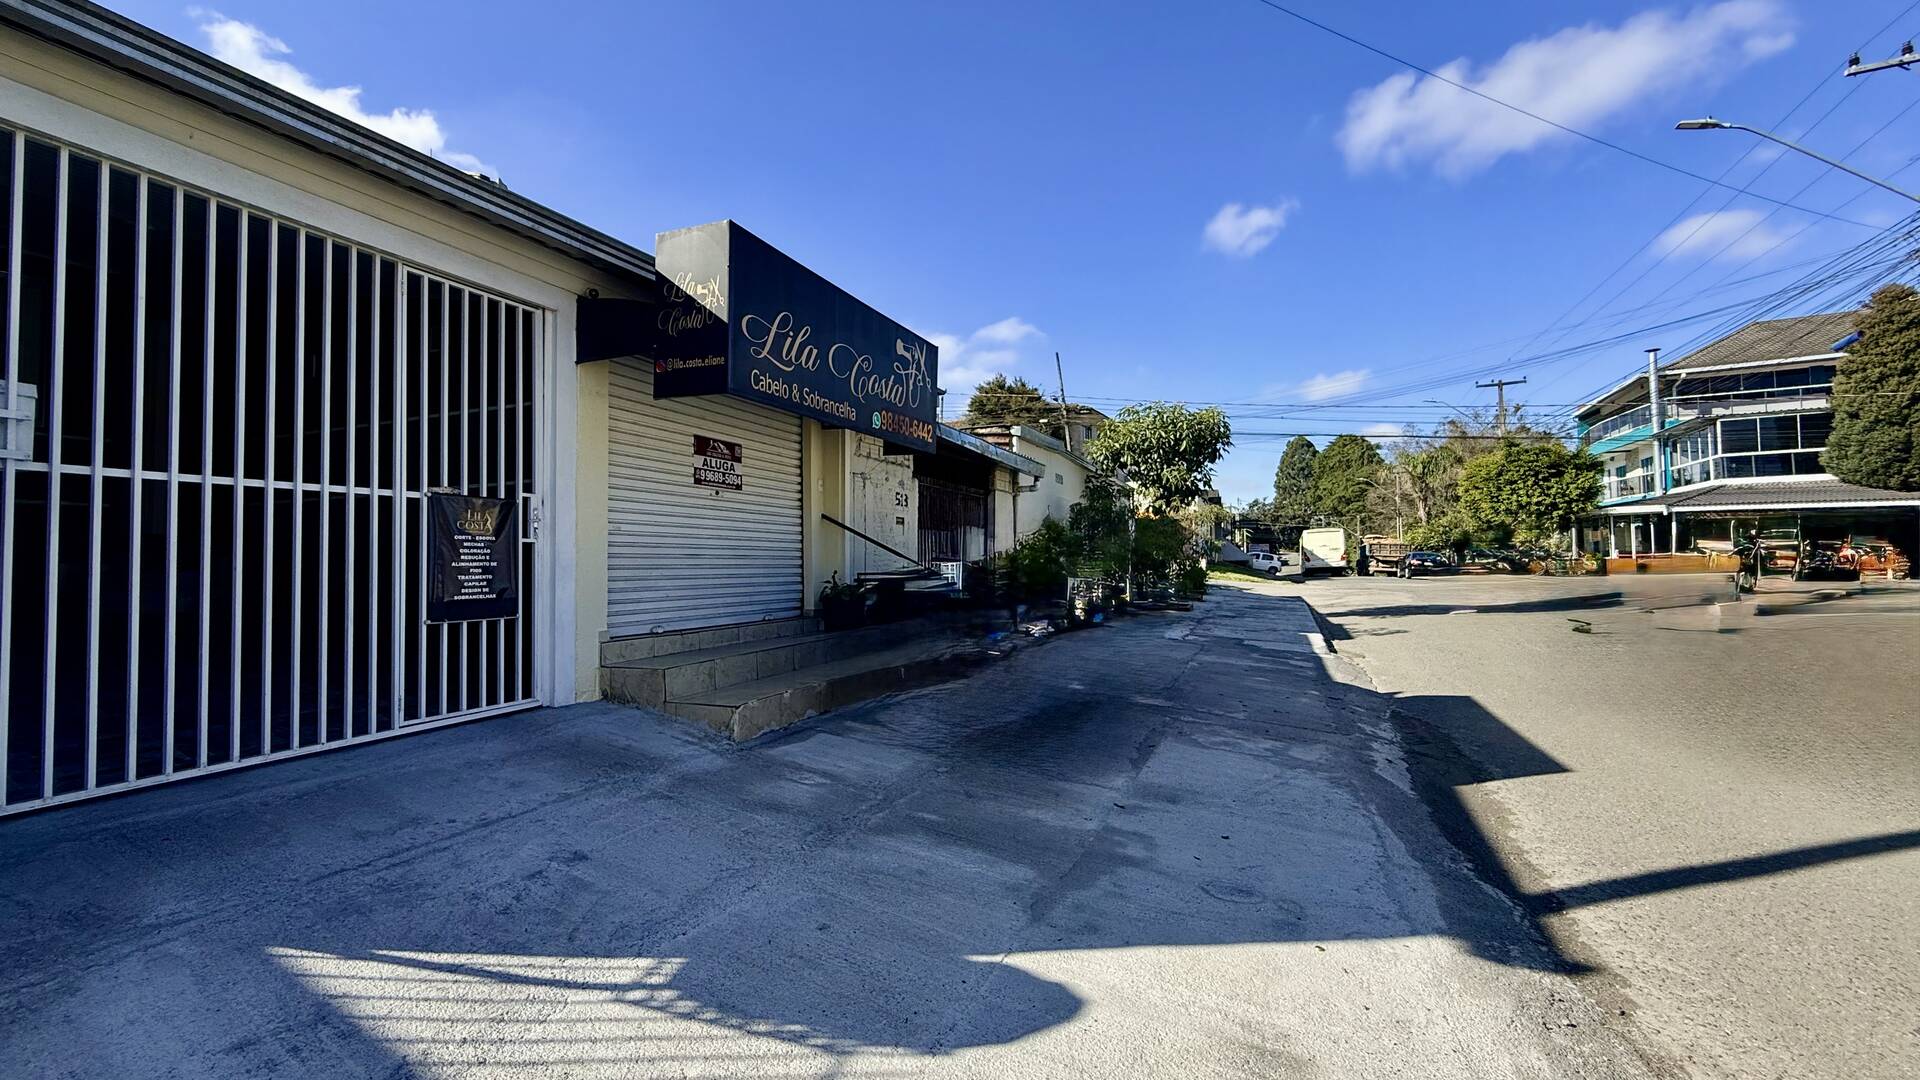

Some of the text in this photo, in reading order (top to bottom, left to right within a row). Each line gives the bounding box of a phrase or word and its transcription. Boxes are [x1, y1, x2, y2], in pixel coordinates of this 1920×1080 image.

[663, 272, 697, 302] Lila
[741, 311, 907, 407] Lila Costa
[751, 369, 856, 421] Cabelo & Sobrancelha
[881, 410, 933, 442] 98450-6442
[702, 457, 736, 473] ALUGA
